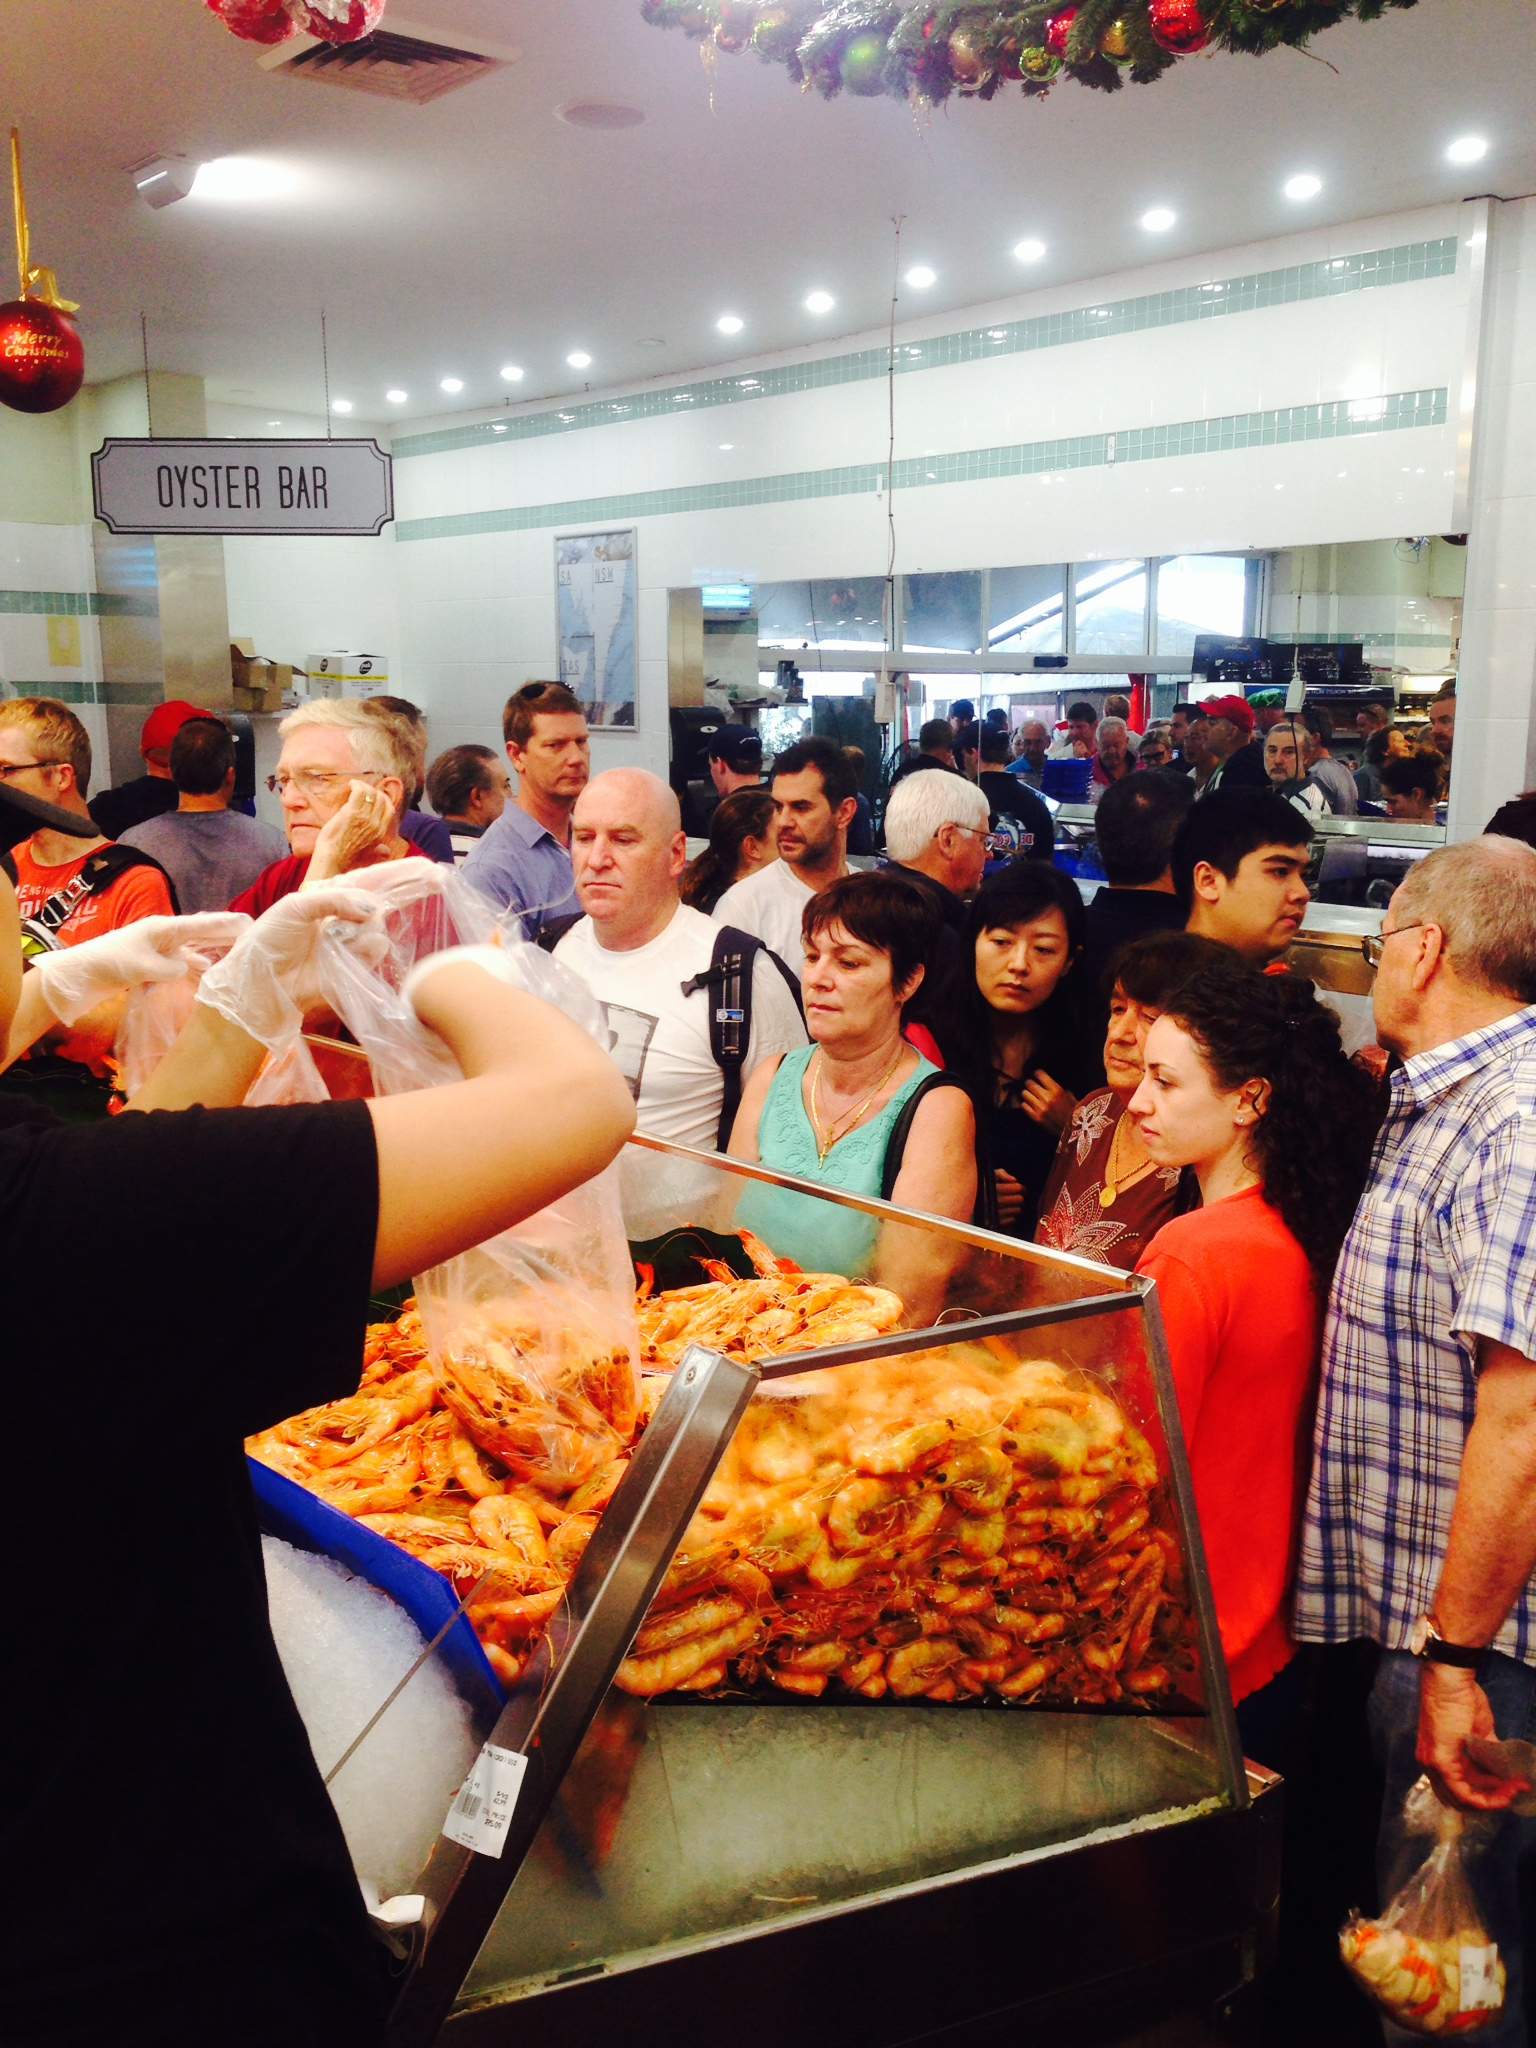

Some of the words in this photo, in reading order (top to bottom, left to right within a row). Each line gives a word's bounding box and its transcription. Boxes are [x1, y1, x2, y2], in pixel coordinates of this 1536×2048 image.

[13, 330, 62, 348] Merry
[157, 465, 261, 509] OYSTER
[278, 465, 329, 509] BAR
